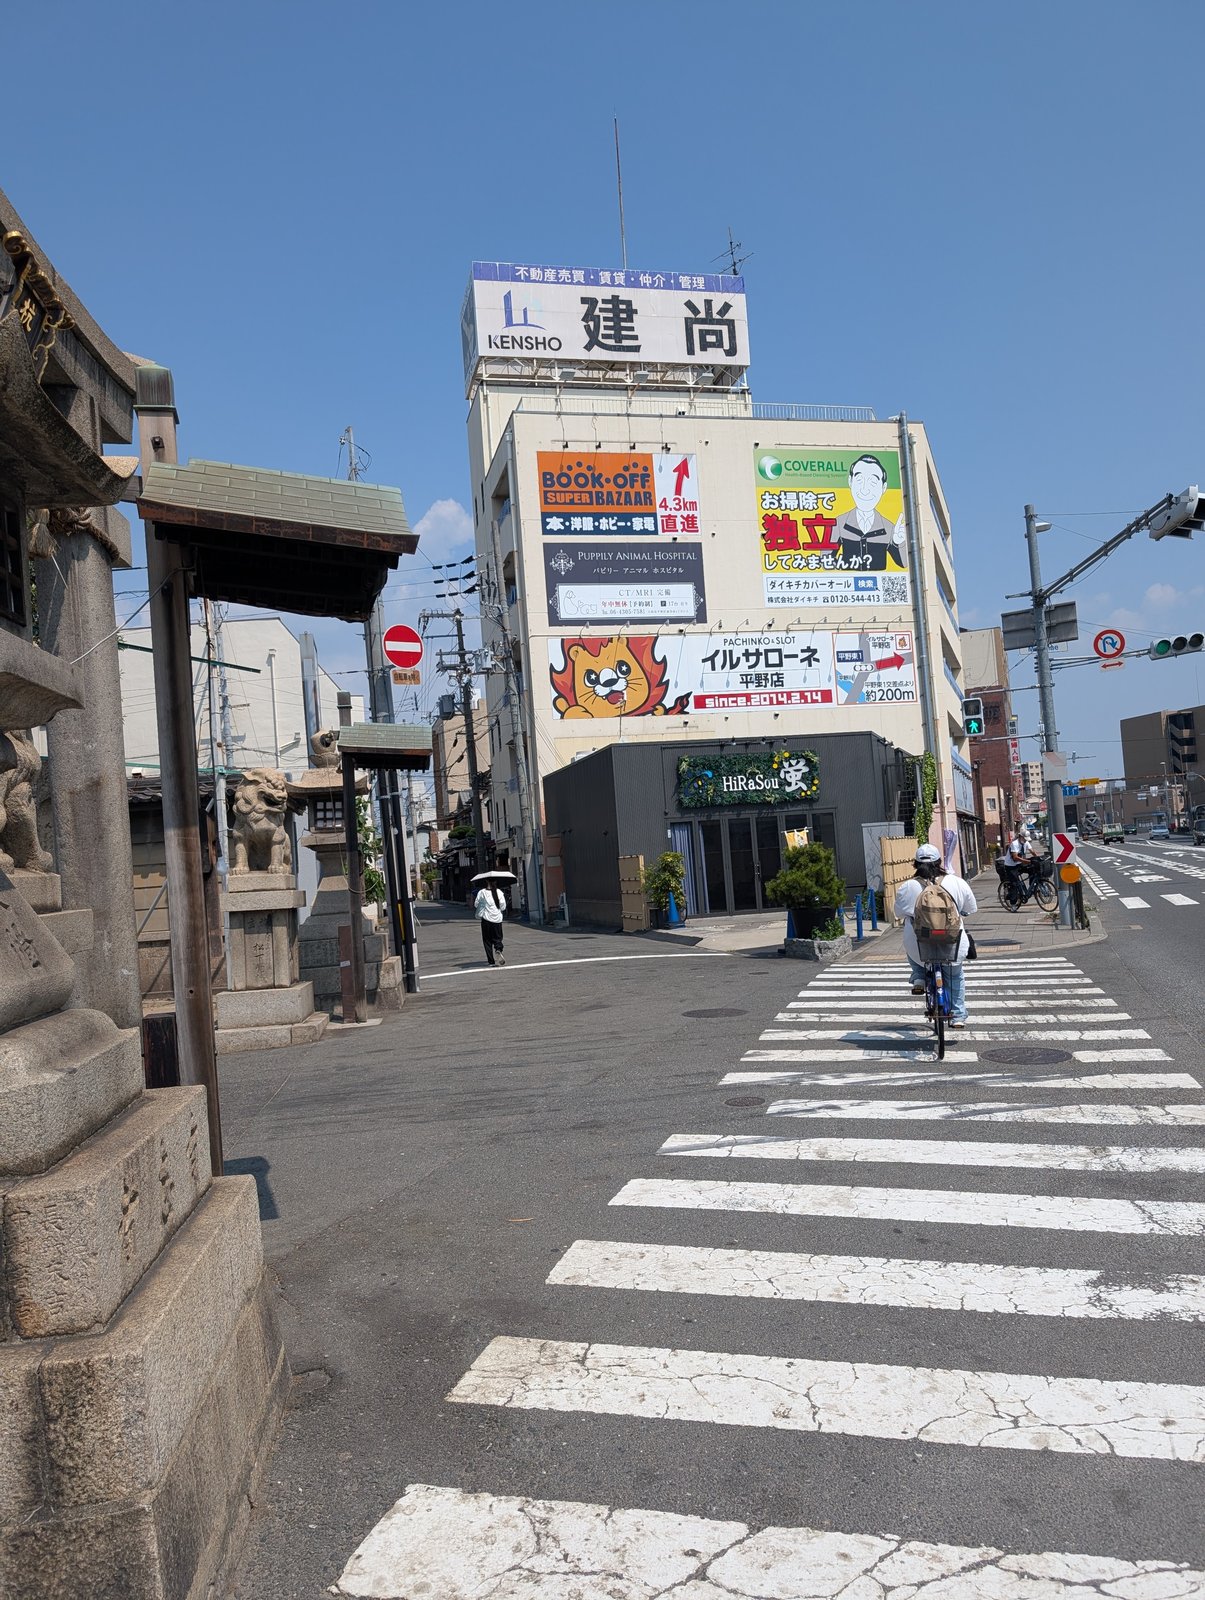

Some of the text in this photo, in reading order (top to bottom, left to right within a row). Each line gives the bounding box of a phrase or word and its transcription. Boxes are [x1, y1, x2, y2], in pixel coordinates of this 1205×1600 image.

[487, 334, 563, 352] KENSHO
[783, 460, 848, 472] COVERALL
[545, 490, 653, 506] SUPER BAZAAR
[658, 497, 699, 512] 4.3km
[761, 491, 836, 511] お掃除で
[660, 514, 699, 534] 直進
[762, 513, 841, 551] 独立
[769, 580, 852, 590] ダイキチカバーオール
[767, 594, 881, 604] 株式会社ダイキチ 0120-544-413
[871, 641, 892, 650] 平野店
[701, 645, 821, 672] イルサローネ
[837, 652, 863, 661] 平野東1
[739, 672, 785, 689] 平野店
[865, 688, 915, 702] 約200m
[722, 774, 780, 792] HiRaSou
